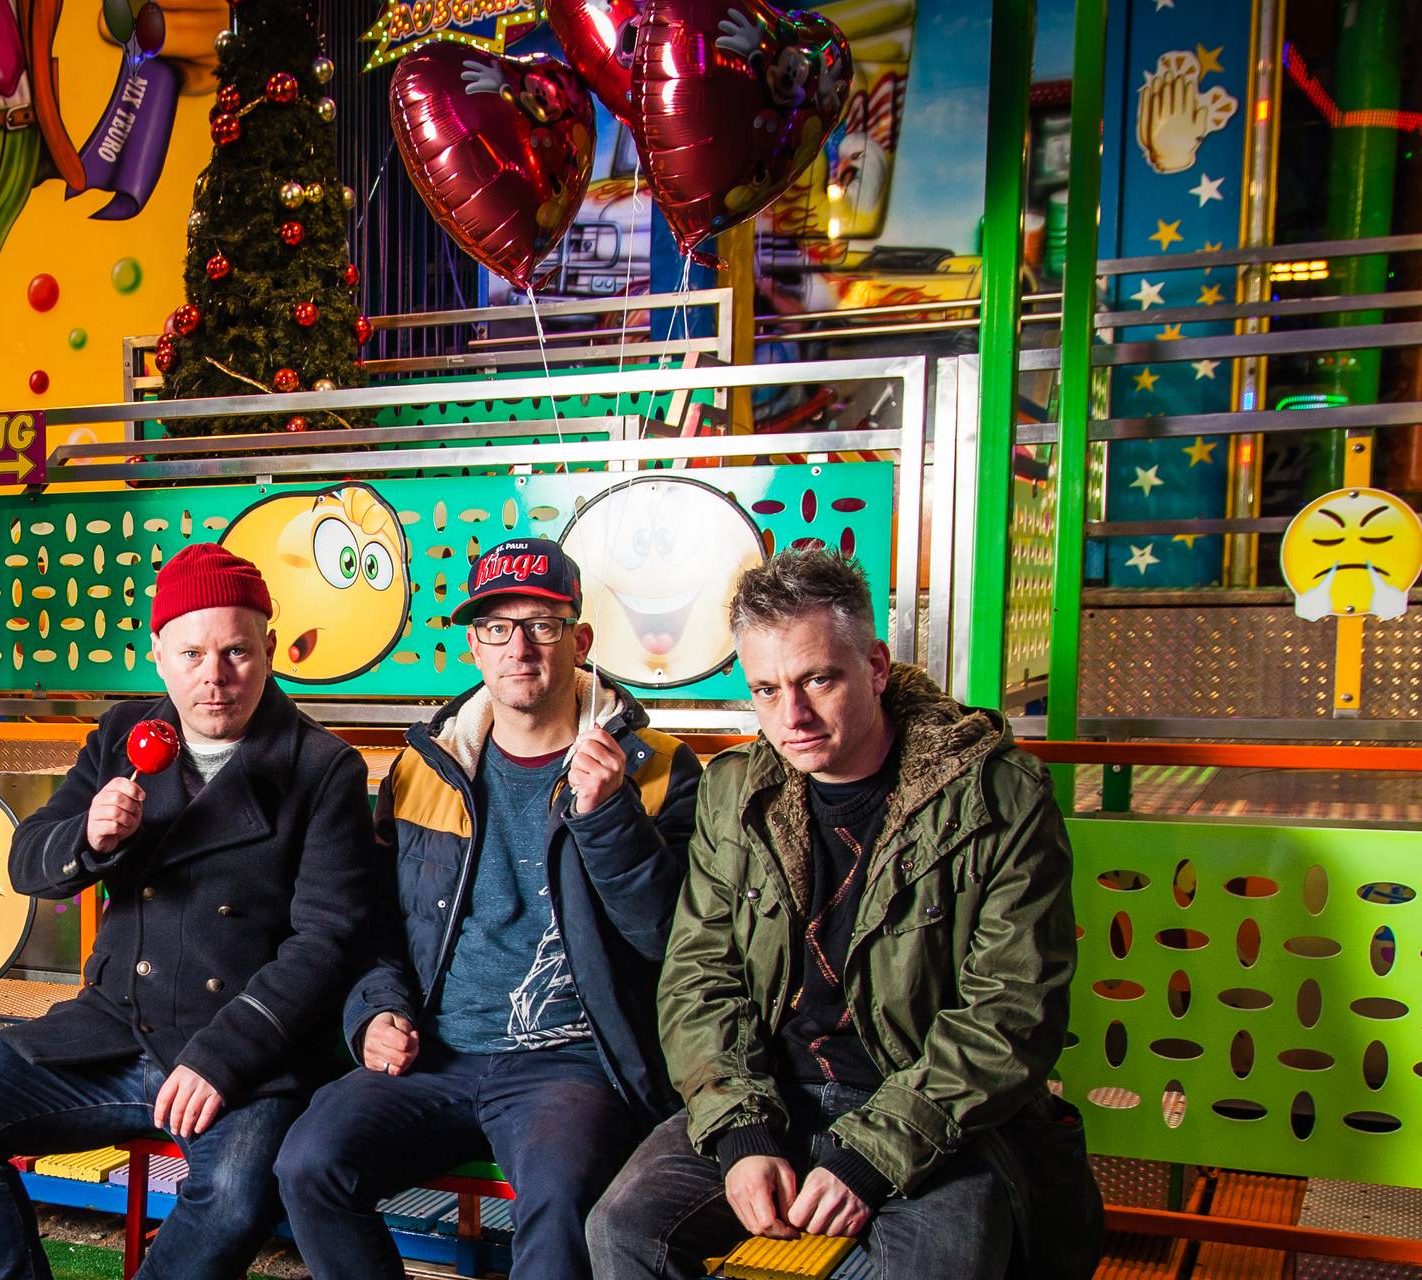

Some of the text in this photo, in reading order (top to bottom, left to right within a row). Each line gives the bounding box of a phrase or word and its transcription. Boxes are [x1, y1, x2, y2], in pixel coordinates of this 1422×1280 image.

[98, 76, 148, 162] NIX TEURO
[505, 543, 529, 551] PAULI
[474, 552, 549, 591] Kings
